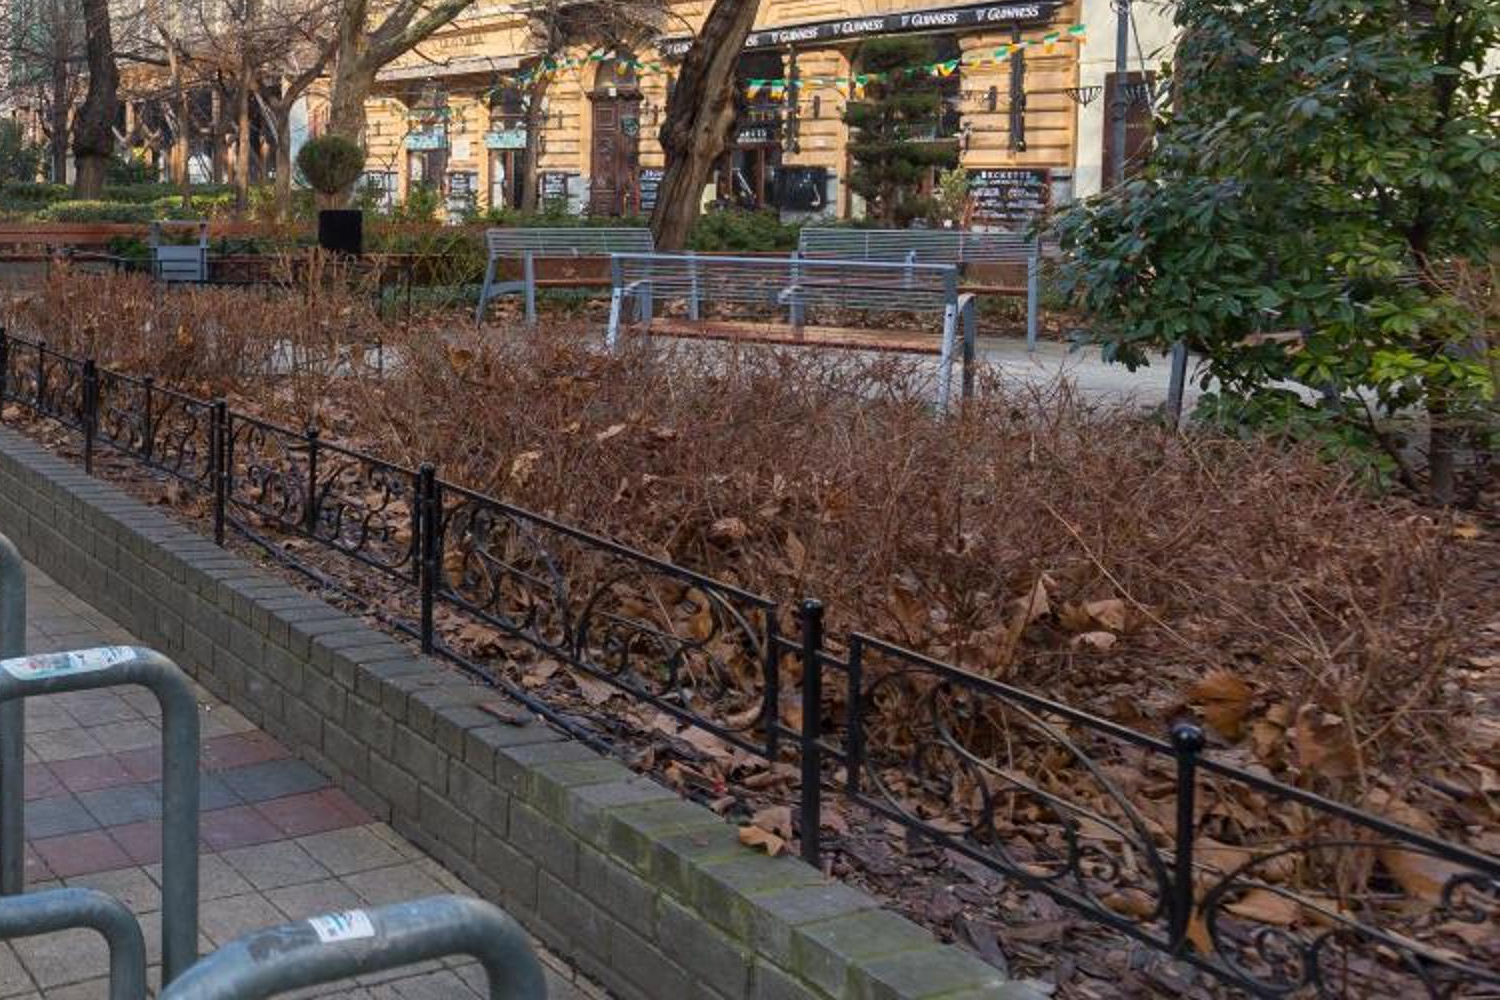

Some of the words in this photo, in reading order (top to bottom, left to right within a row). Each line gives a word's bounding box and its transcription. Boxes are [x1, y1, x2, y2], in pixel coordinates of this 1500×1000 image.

[779, 26, 819, 43] GUINNESS
[842, 19, 885, 34] GUINNESS
[911, 12, 959, 26] GUINNESS
[987, 4, 1040, 20] GUINNESS
